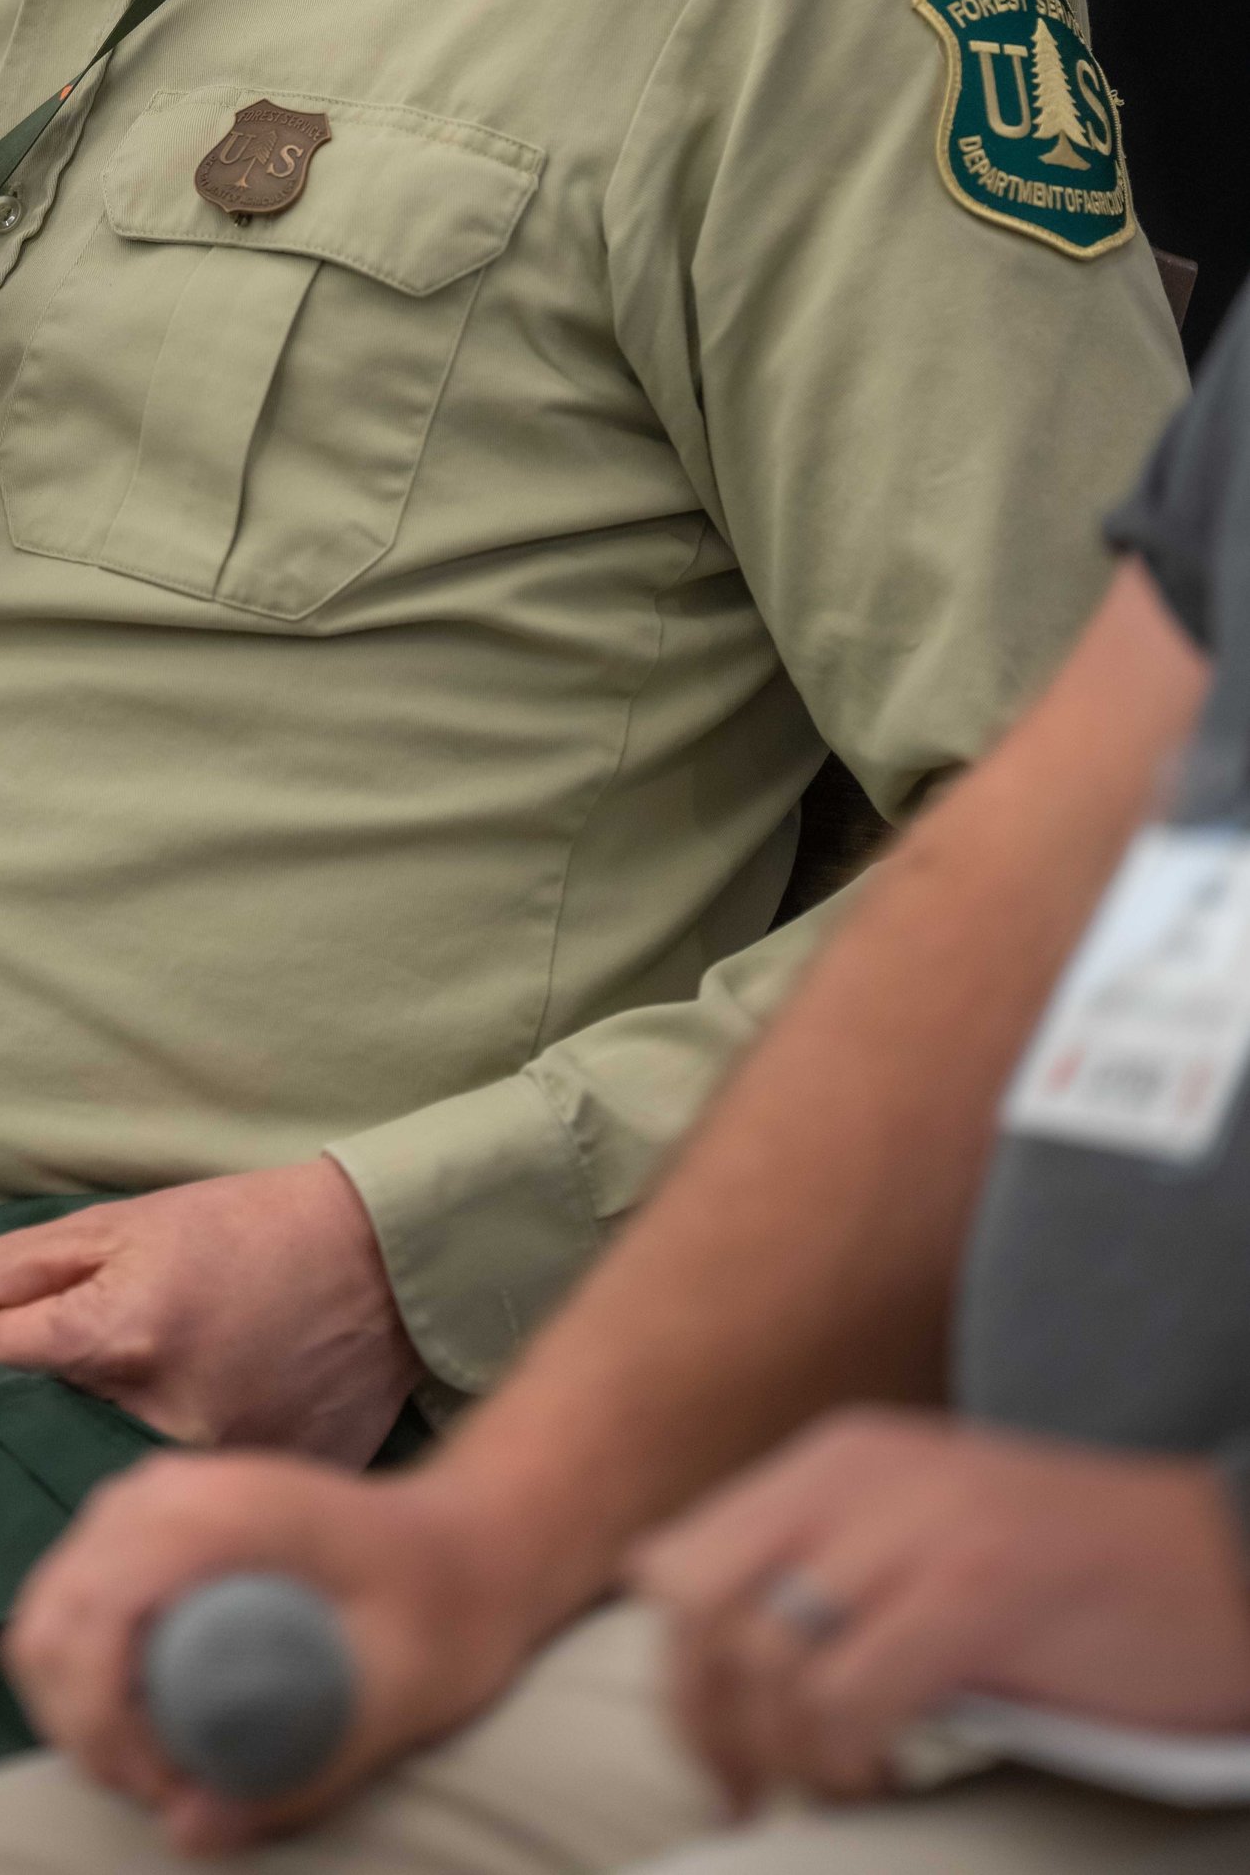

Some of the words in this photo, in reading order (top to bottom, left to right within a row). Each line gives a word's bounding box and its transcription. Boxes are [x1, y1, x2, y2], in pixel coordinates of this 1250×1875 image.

[237, 109, 283, 123] FOREST
[281, 113, 325, 141] SERVICE
[958, 134, 1064, 211] DEPARTMENT
[1064, 186, 1083, 213] OF
